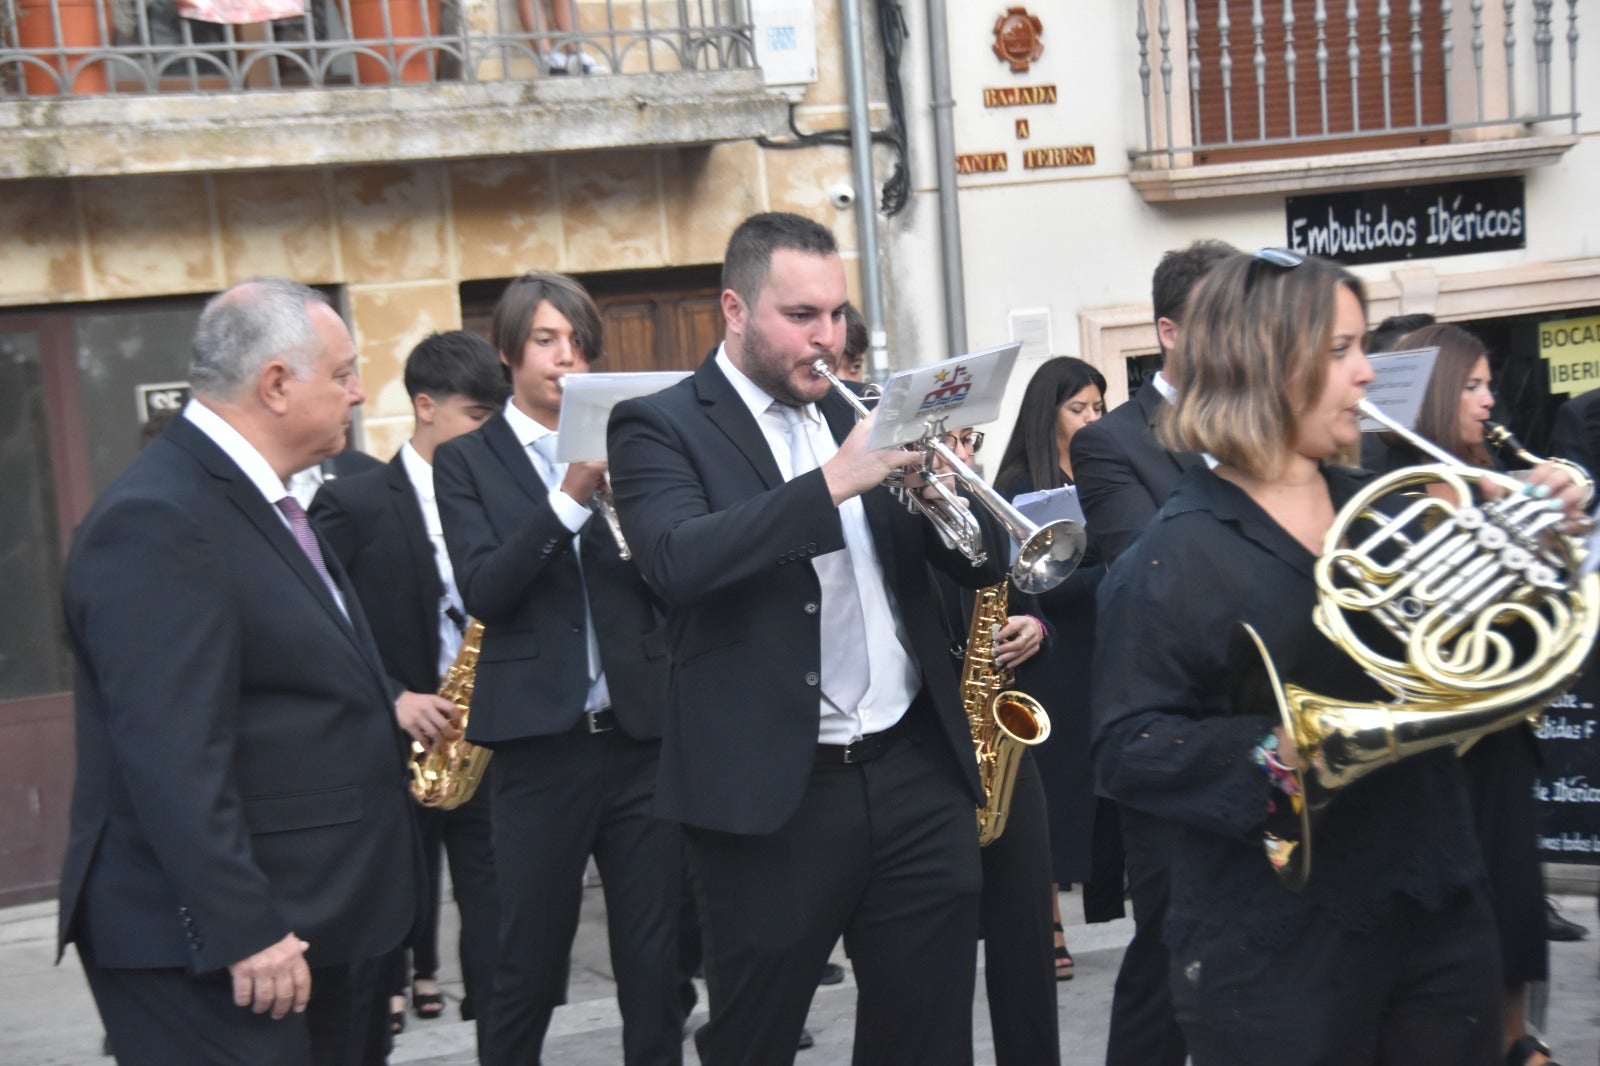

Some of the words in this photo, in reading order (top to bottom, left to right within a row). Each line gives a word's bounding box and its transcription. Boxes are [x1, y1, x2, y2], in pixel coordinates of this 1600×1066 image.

[984, 86, 1056, 107] BAJADA
[1018, 120, 1029, 138] A
[1025, 147, 1095, 168] TERESA
[1292, 205, 1416, 256] Embutidos
[1426, 195, 1522, 245] Ibéricos
